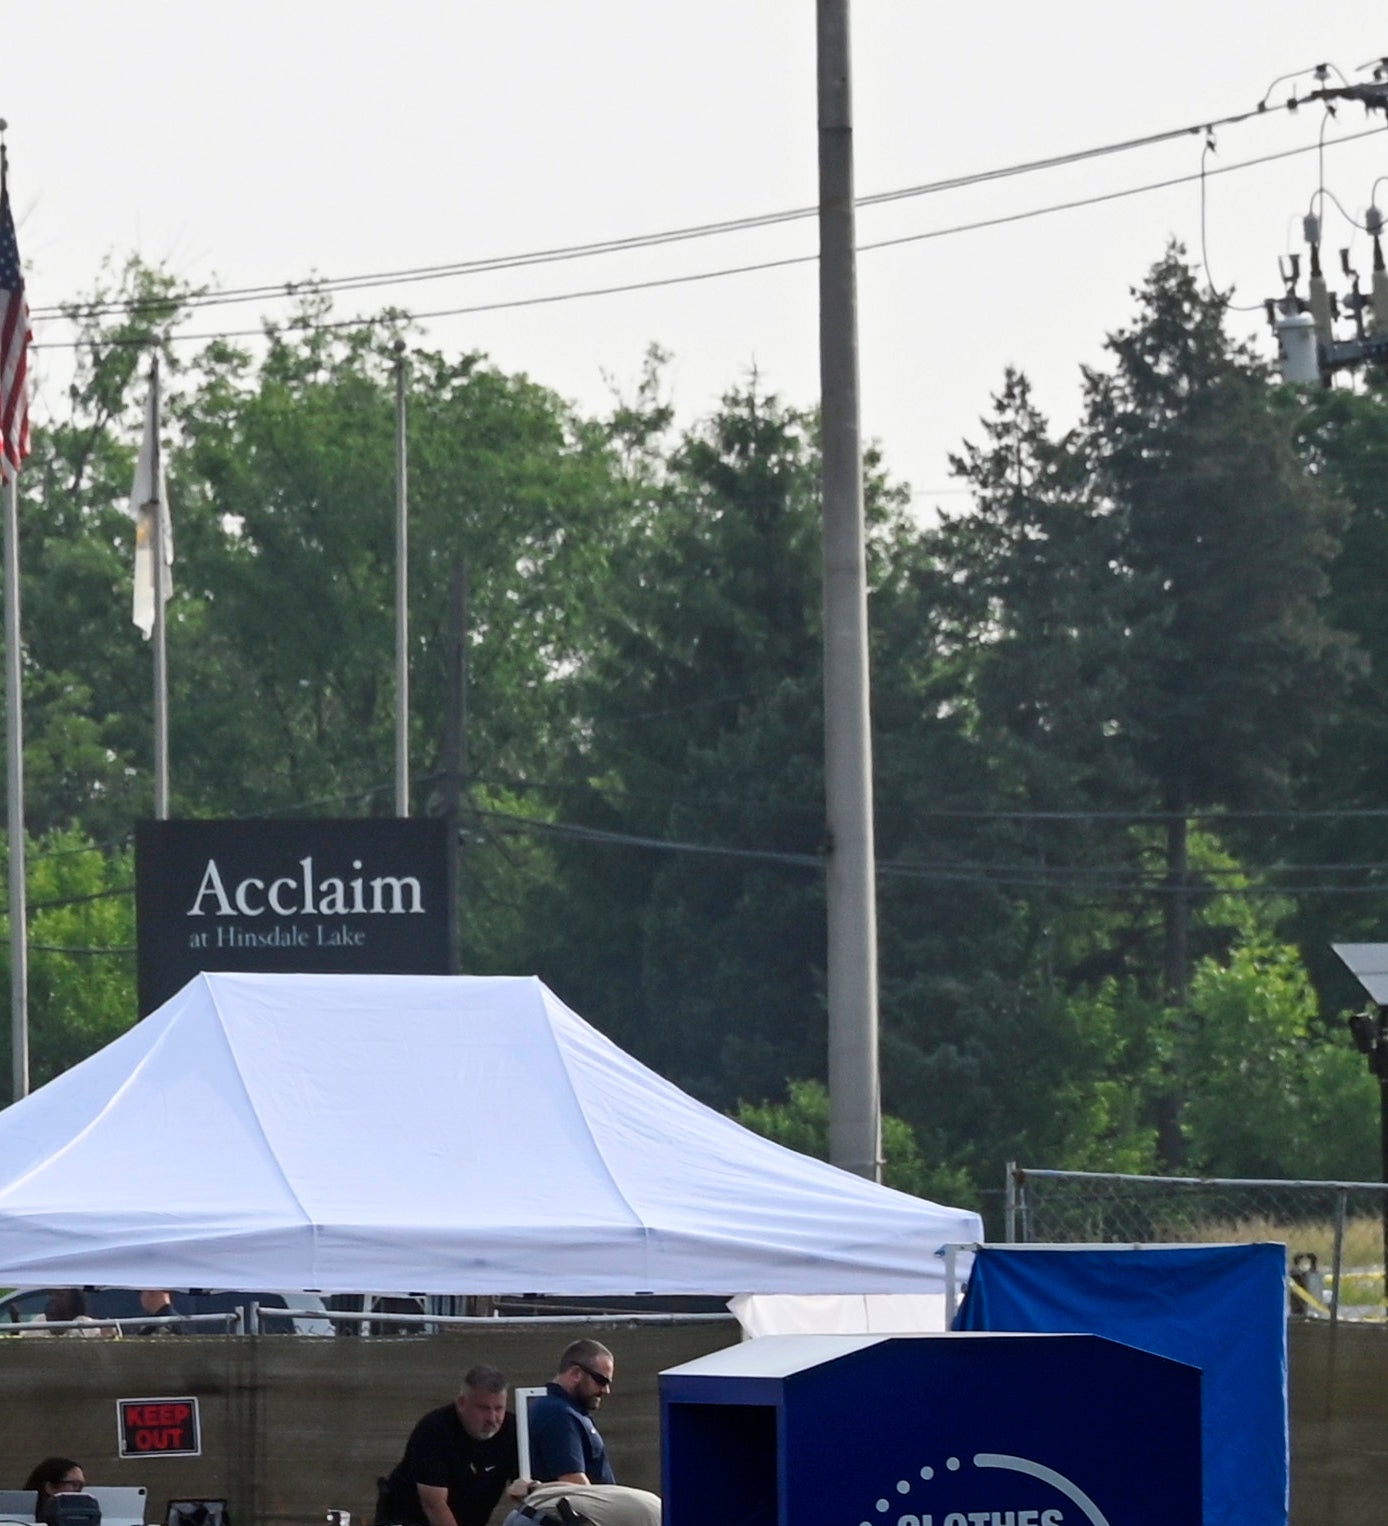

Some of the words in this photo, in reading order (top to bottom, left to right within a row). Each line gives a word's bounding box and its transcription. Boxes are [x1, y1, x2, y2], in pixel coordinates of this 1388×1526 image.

[186, 855, 427, 917] Acclaim
[189, 930, 208, 949] at
[216, 925, 310, 948] Hinsdale
[317, 924, 366, 947] Lake
[126, 1404, 190, 1427] KEEP
[135, 1428, 184, 1451] OUT
